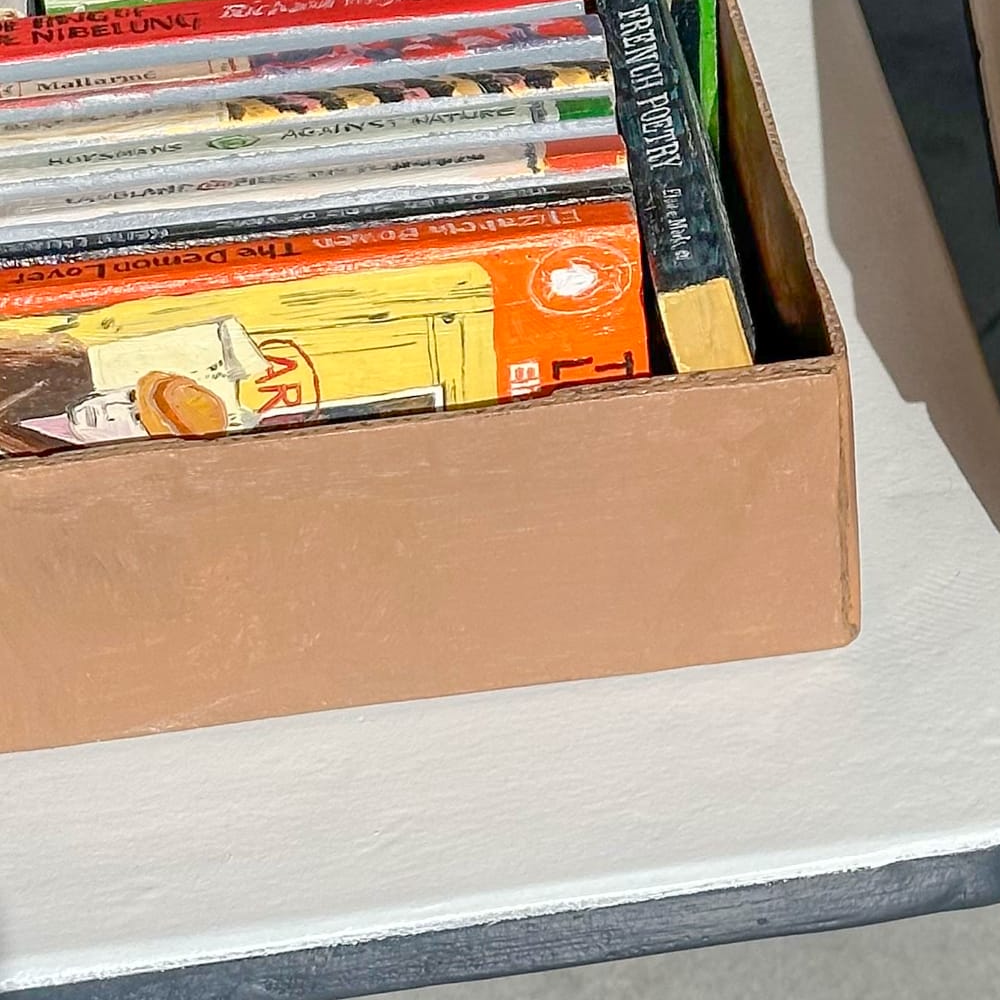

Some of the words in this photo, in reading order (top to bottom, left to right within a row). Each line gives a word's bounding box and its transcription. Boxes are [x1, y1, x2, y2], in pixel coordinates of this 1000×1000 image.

[616, 2, 666, 94] FRENCH
[639, 96, 684, 172] POETRY
[116, 248, 236, 276] Demon
[244, 243, 300, 264] The
[9, 263, 108, 289] Lover
